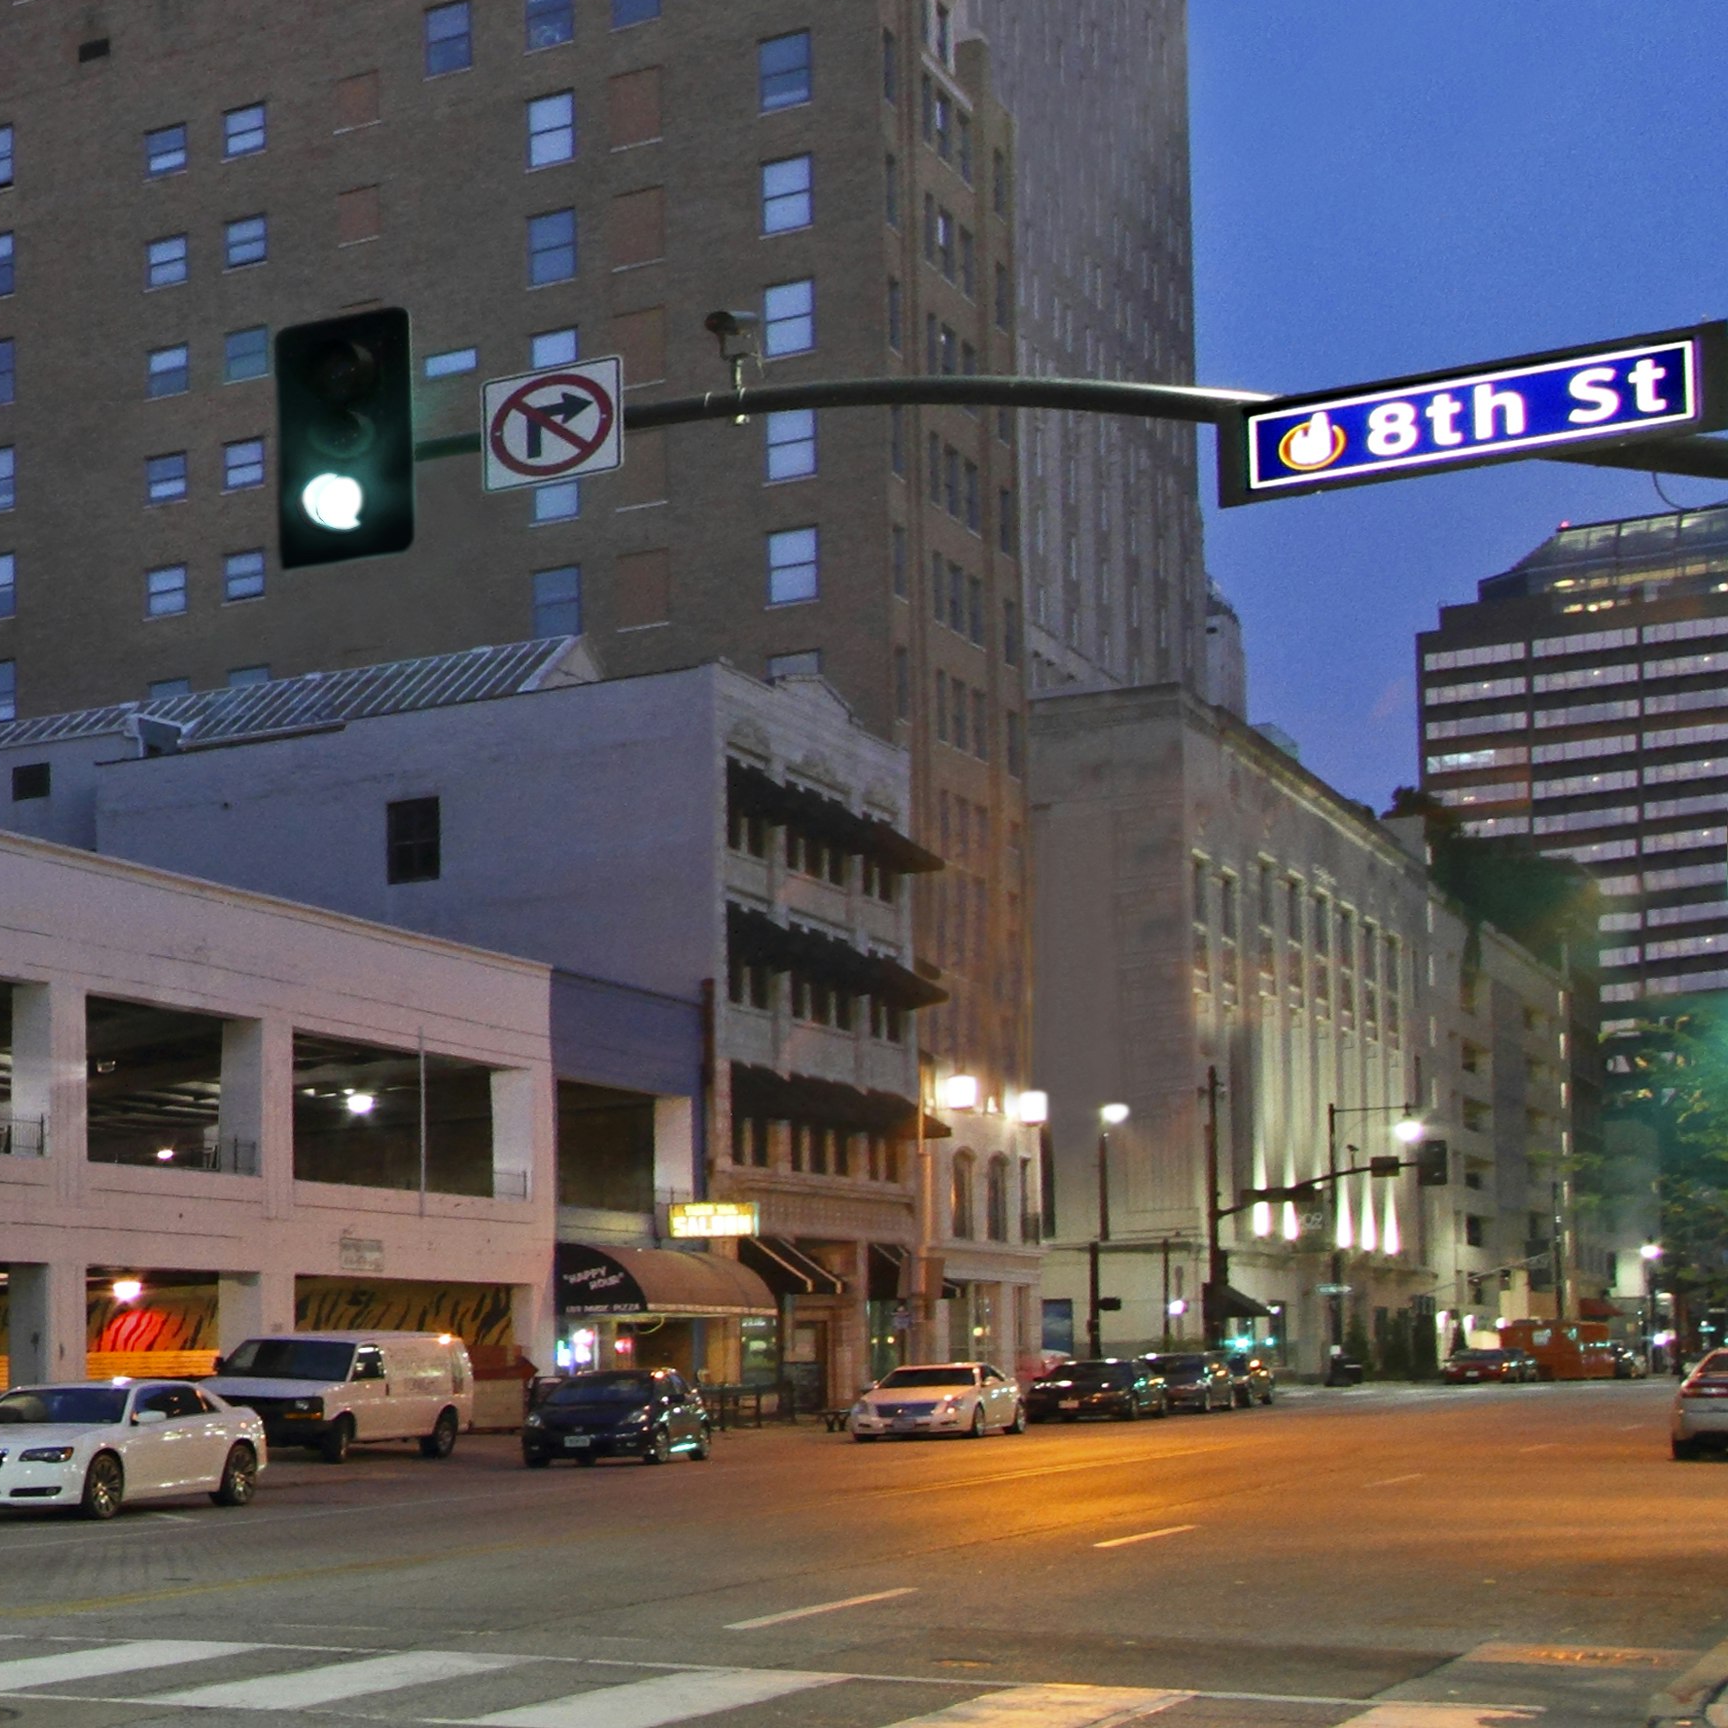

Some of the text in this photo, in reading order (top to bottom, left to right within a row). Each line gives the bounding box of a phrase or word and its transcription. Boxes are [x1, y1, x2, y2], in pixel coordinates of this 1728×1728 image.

[1367, 358, 1667, 457] 8th St
[672, 1214, 752, 1237] SALOON
